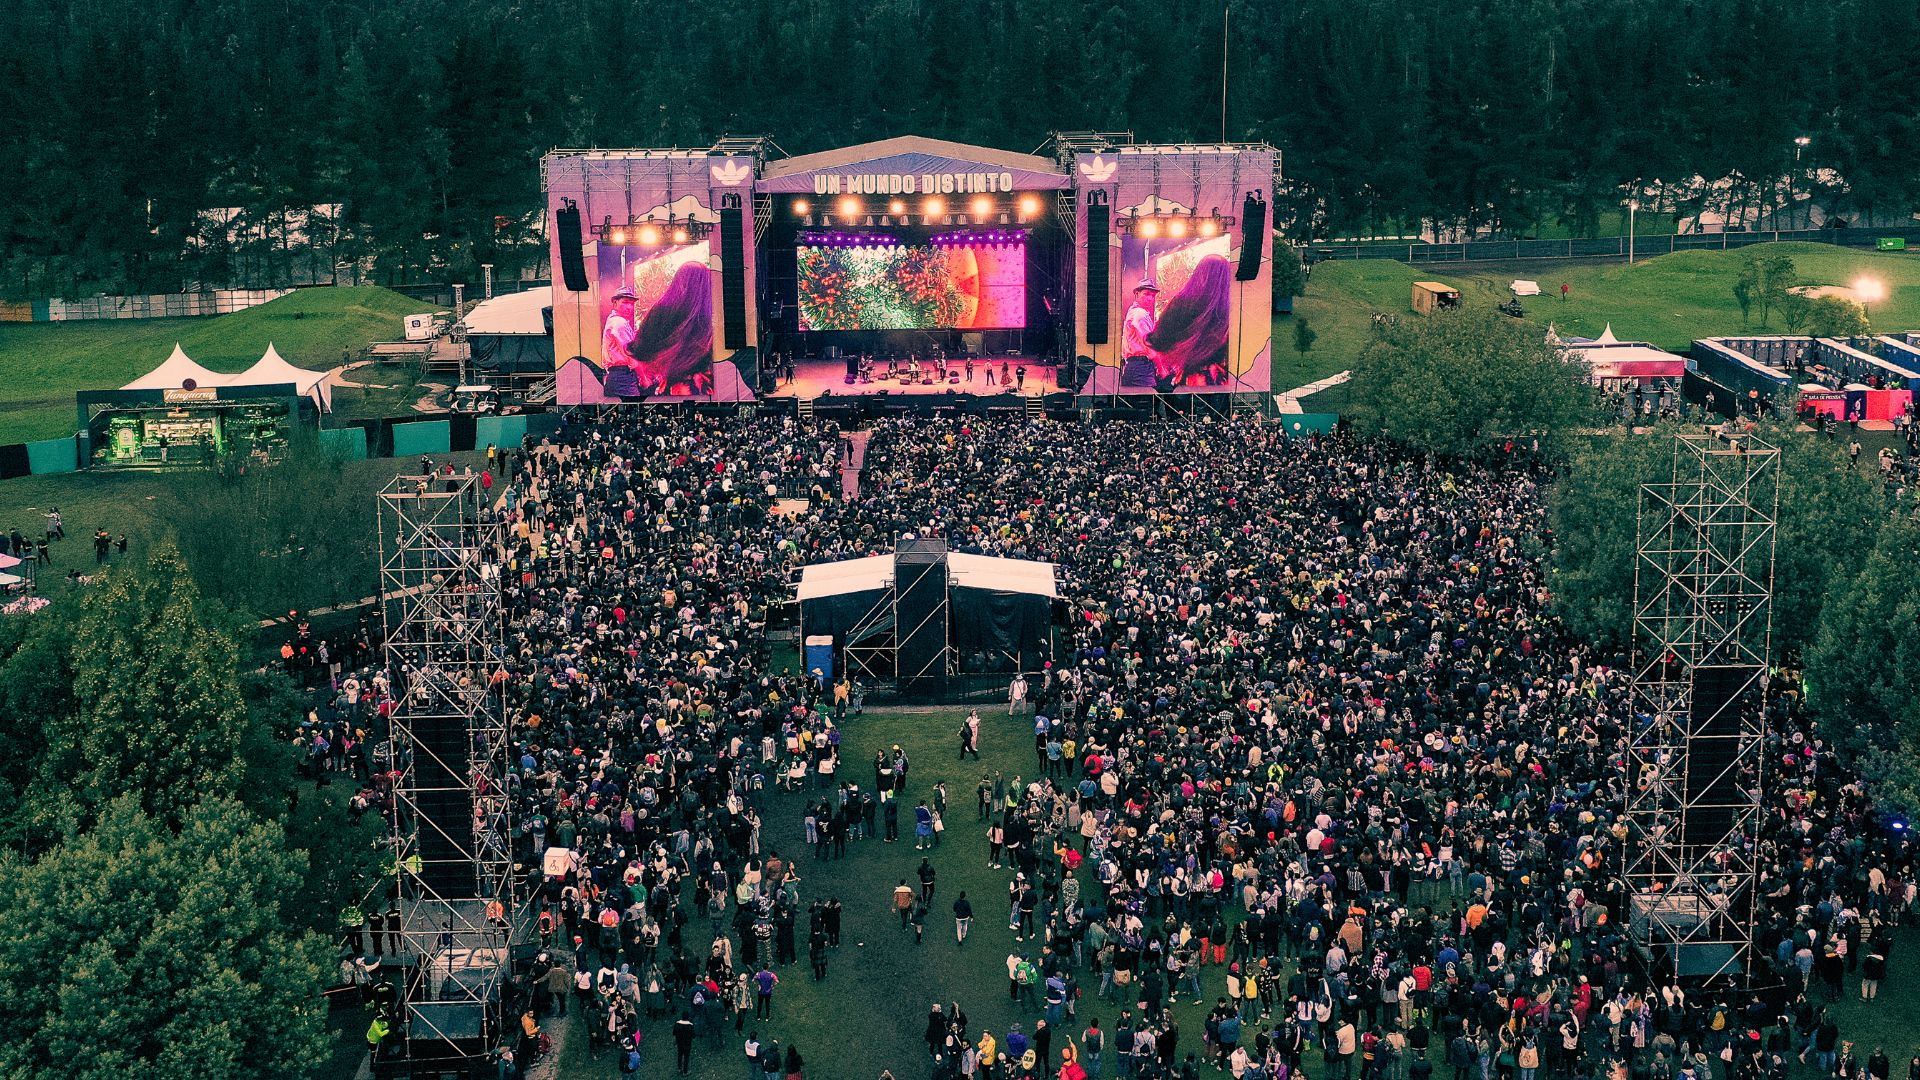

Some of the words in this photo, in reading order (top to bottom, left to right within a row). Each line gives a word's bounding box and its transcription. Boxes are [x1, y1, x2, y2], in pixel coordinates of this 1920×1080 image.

[814, 174, 840, 194] UN
[849, 174, 915, 194] MUNDO
[921, 173, 1013, 194] DISTINTO
[165, 390, 216, 401] Tanqueray
